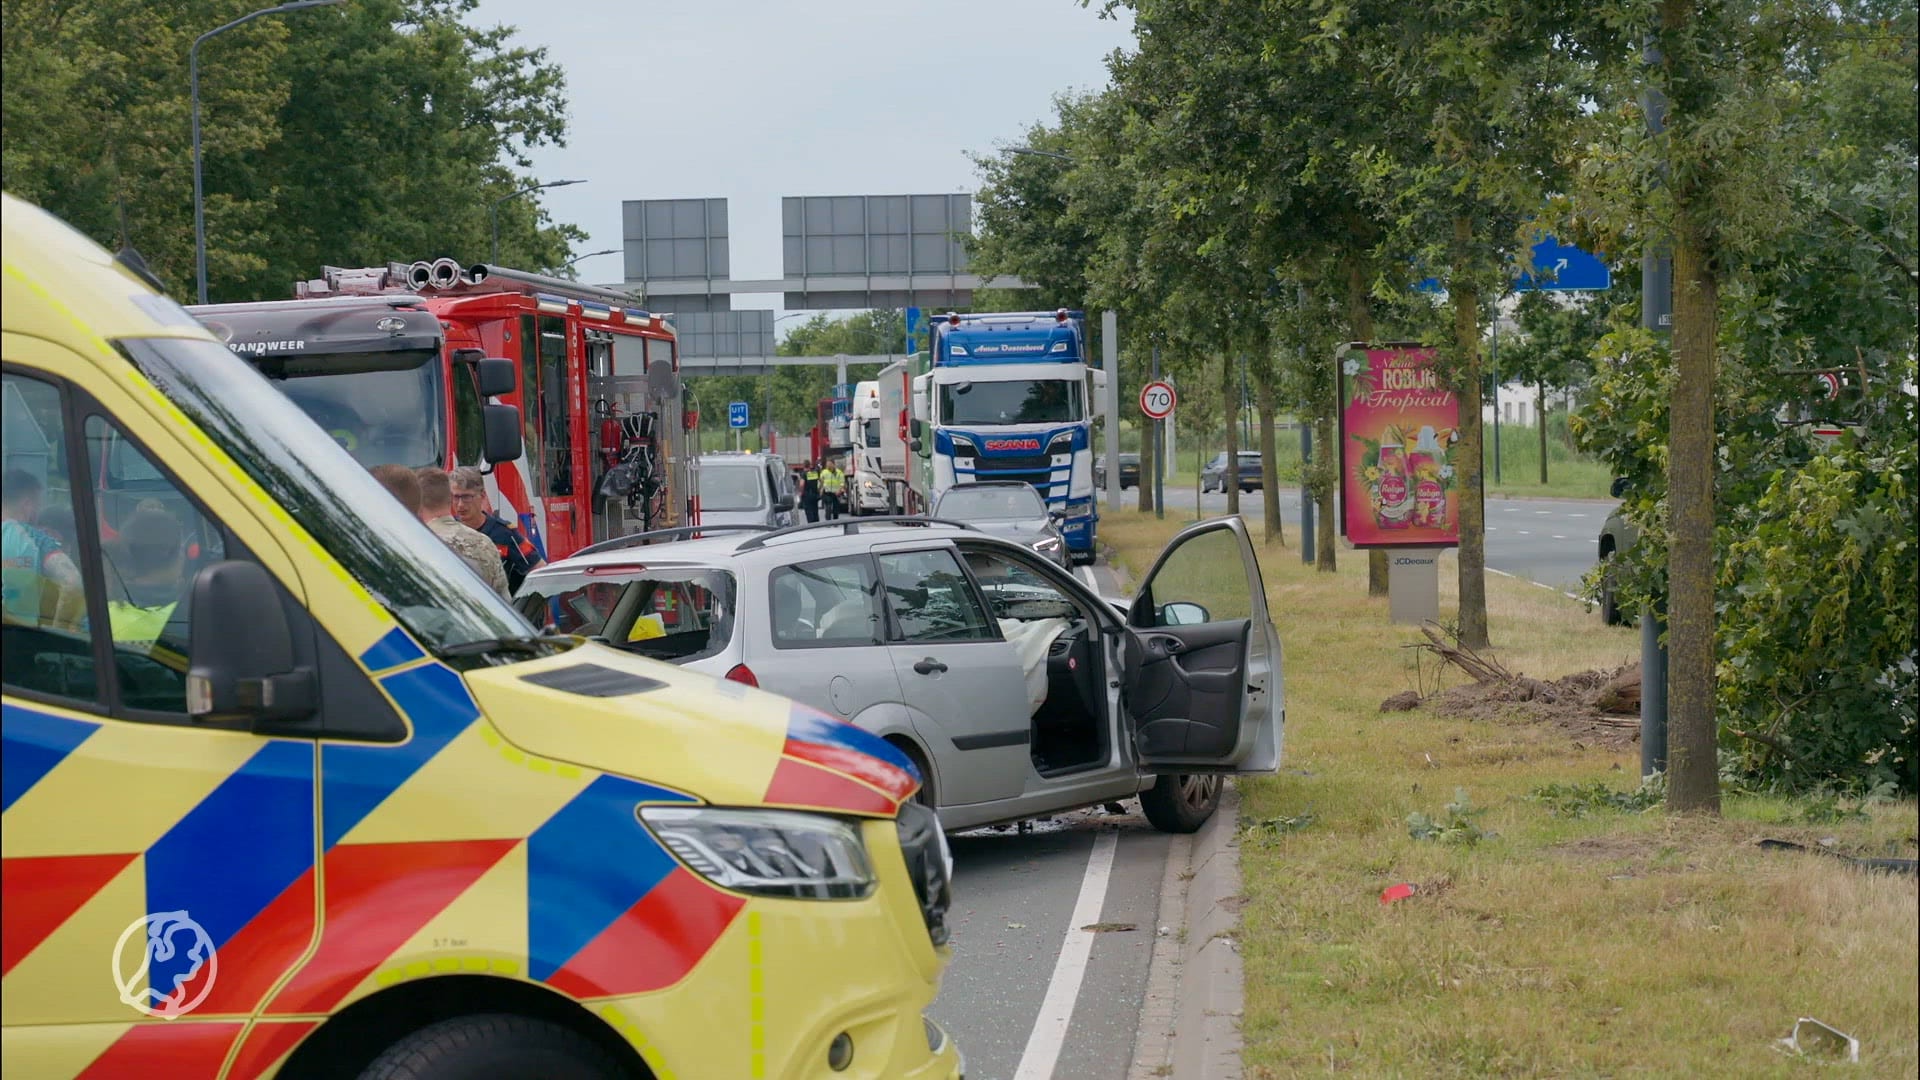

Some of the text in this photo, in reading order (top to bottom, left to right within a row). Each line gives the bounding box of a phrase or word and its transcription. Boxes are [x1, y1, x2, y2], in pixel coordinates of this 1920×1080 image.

[229, 340, 305, 353] RANDWEER
[1148, 393, 1170, 406] 70
[1368, 389, 1451, 413] Tropical
[986, 439, 1040, 451] SCANIA
[1394, 557, 1433, 565] JCDecaux
